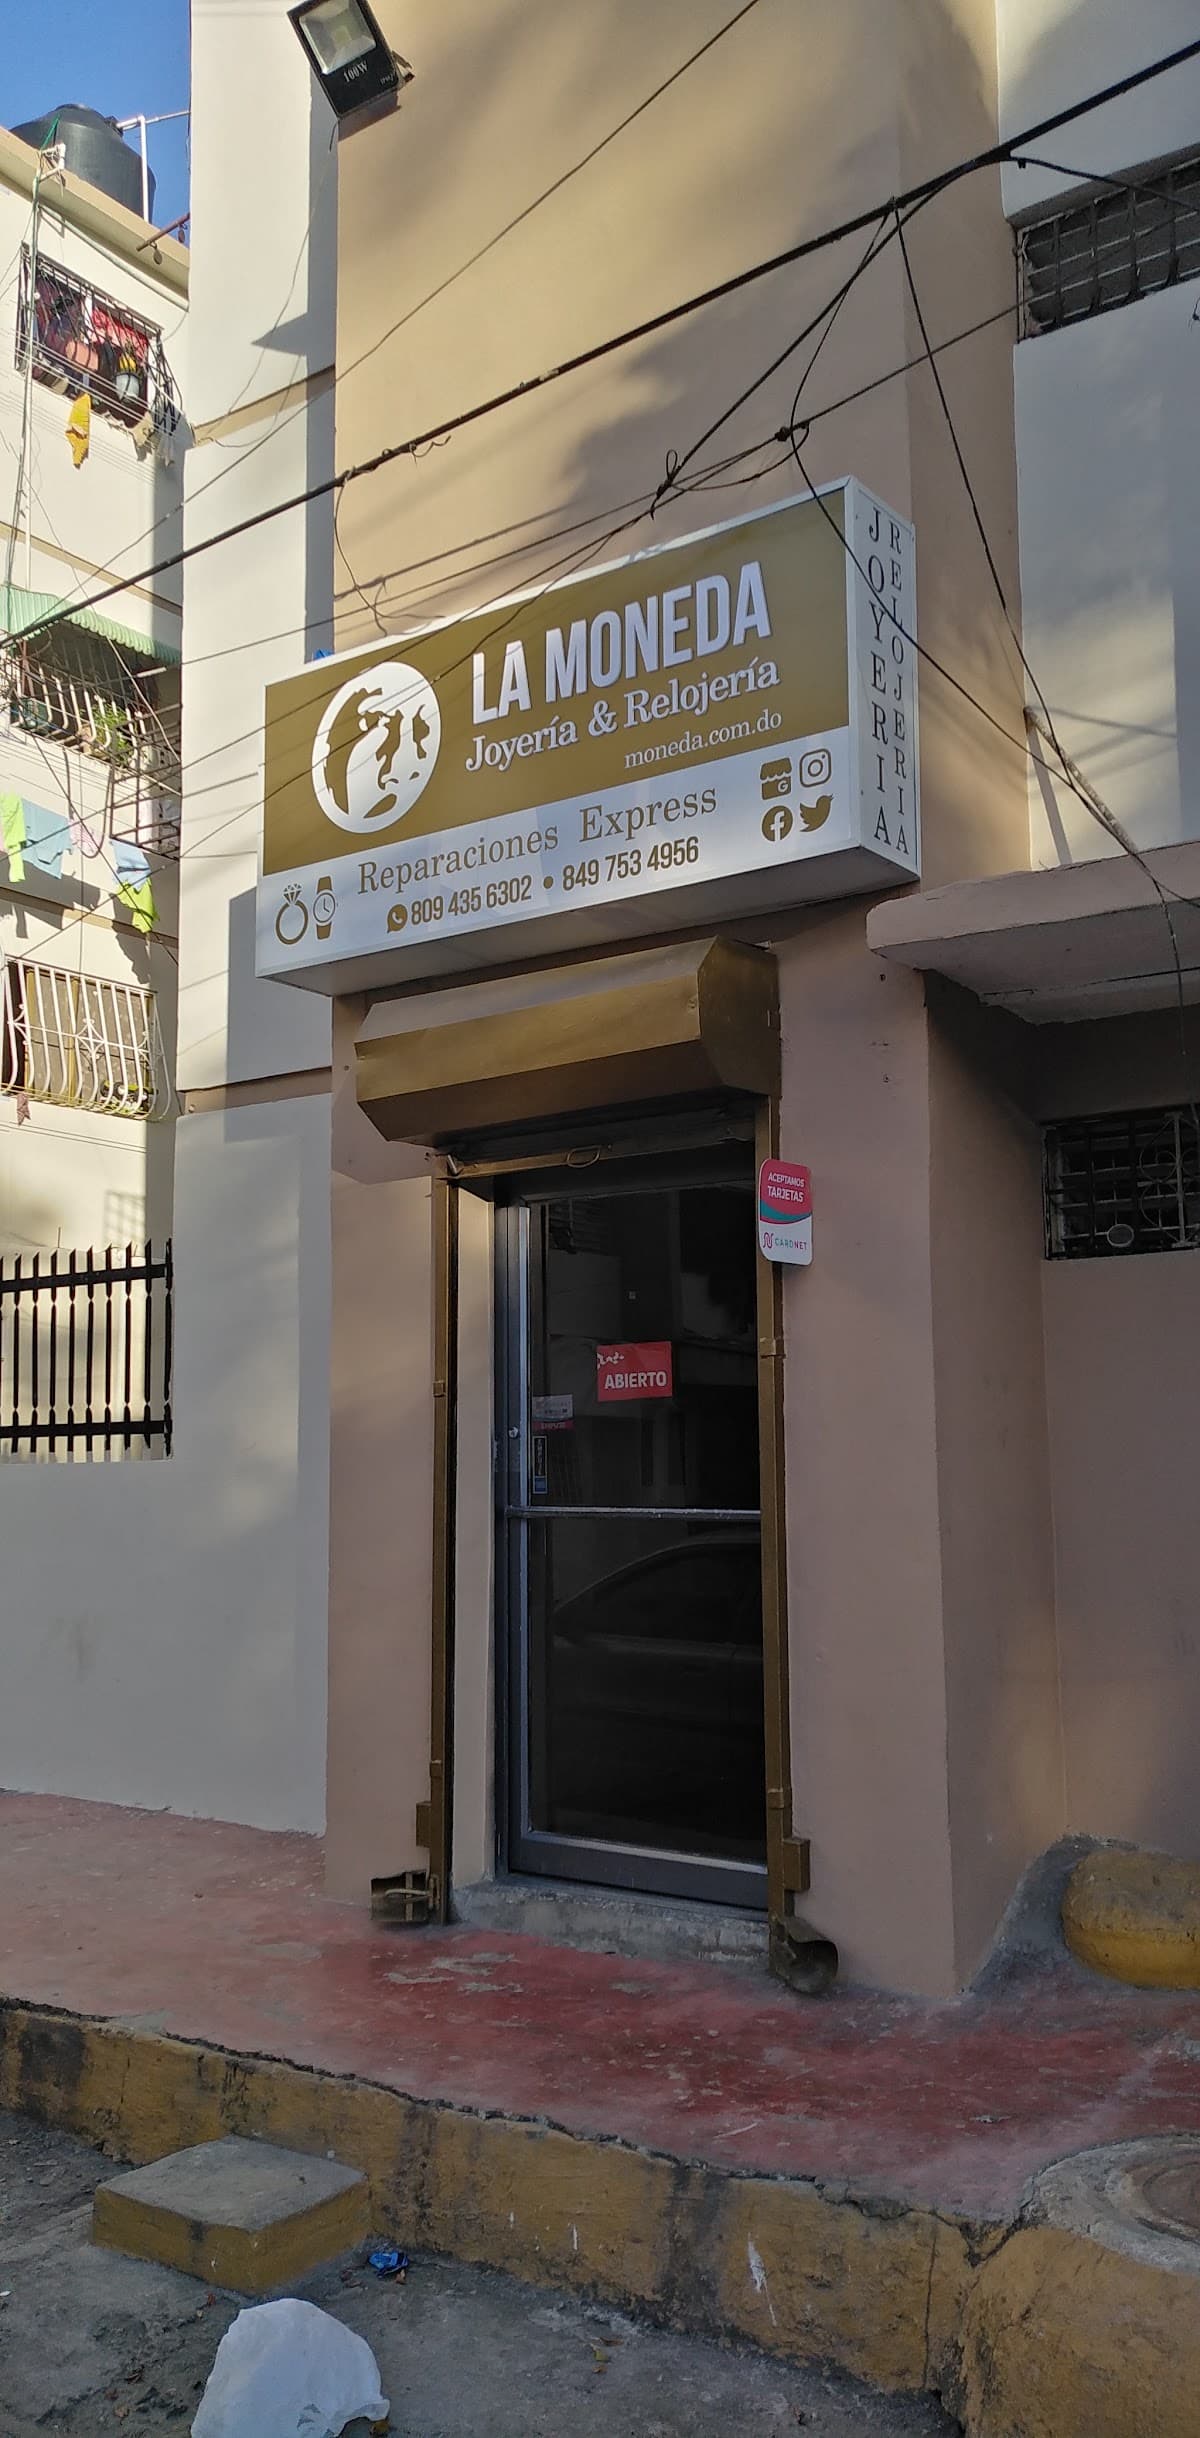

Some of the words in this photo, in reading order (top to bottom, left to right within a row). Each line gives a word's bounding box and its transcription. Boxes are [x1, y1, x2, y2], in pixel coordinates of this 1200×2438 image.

[343, 60, 368, 82] 100W
[472, 639, 532, 725] LA
[545, 560, 772, 704] MONEDA
[868, 507, 891, 845] JOYERIA
[465, 715, 578, 772] Joyería
[588, 700, 618, 737] &
[623, 656, 781, 728] Relojería
[889, 520, 909, 855] RELOJERIA
[623, 708, 783, 769] moneda.com.do
[357, 825, 559, 894] Reparaciones
[579, 787, 718, 843] Express
[410, 895, 444, 926] 809
[447, 885, 482, 917] 435
[486, 874, 532, 909] 6302
[562, 859, 600, 891] 849
[604, 848, 642, 882] 753
[646, 835, 699, 872] 4956
[767, 1185, 805, 1203] TARJETAS
[768, 1171, 805, 1188] ACEPTAMOS
[774, 1238, 807, 1251] CARDNET
[604, 1371, 667, 1390] ABIERTO
